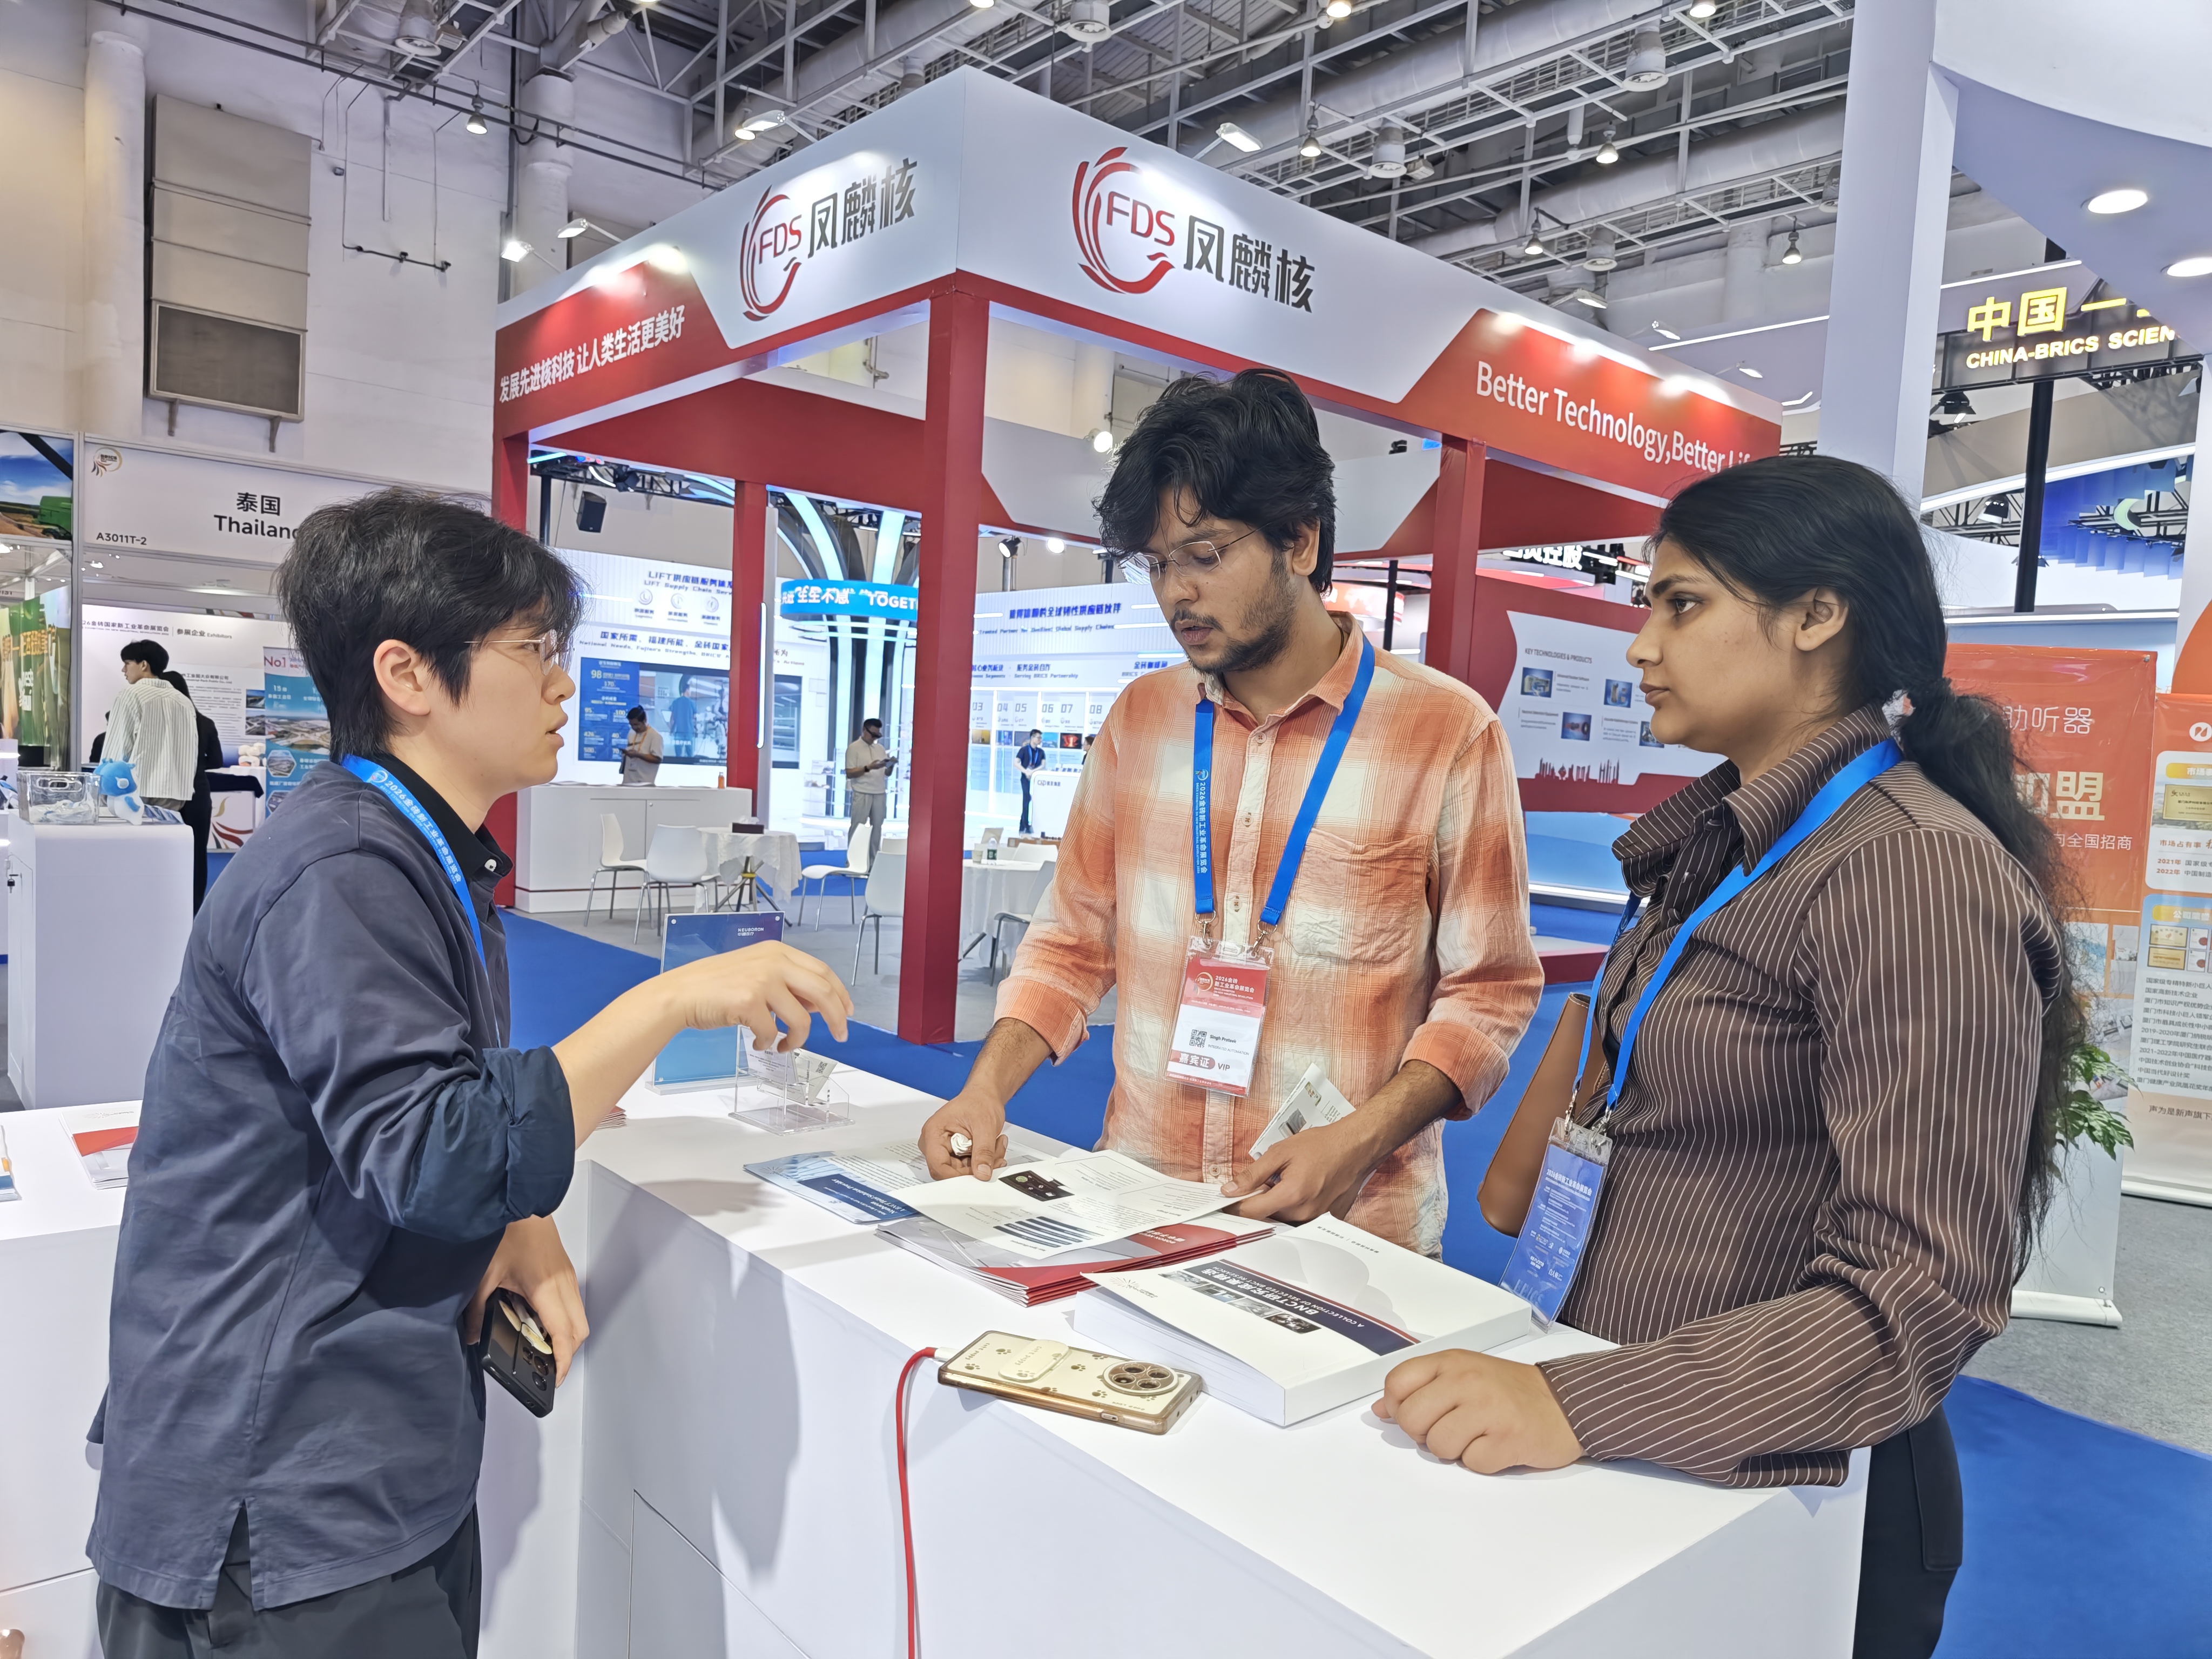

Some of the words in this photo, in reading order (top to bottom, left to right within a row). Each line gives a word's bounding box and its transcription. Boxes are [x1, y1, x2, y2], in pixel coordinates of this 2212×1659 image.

[1107, 191, 1175, 247] FDS
[759, 214, 802, 265] FDS
[1183, 215, 1316, 313] 凤麟核
[500, 350, 575, 403] 发展先进核科技
[577, 305, 685, 374] 让人类生活更美好
[1966, 335, 2099, 369] CHINA-BRICS
[1476, 360, 1548, 416] Better
[1729, 450, 1751, 468] Lif
[237, 492, 281, 516] 泰国
[96, 532, 147, 545] A3011T-2
[177, 628, 205, 637] 参展企业
[1534, 649, 1566, 660] TECHNOLOGIES
[1570, 655, 1592, 664] PRODUCTS
[1015, 703, 1027, 712] 05
[1042, 704, 1054, 713] 06
[1061, 704, 1073, 713] 07
[1089, 705, 1103, 714] 08
[385, 780, 461, 882] 2026金砖新工业革命展览会
[1199, 782, 1208, 874] 2026金砖新工业革命展览会
[1215, 975, 1238, 984] 2026金砖
[1227, 1048, 1249, 1056] AUTOMATION
[2139, 1047, 2212, 1061] 2021-2022年中国医疗器
[1179, 1053, 1210, 1068] 嘉宾证
[1218, 1062, 1230, 1071] VIP
[2148, 1105, 2212, 1121] 声为是新声旗下
[1212, 1266, 1247, 1280] RESEARCH
[1266, 1286, 1301, 1301] SELECTED
[1311, 1304, 1357, 1325] COLLECTION
